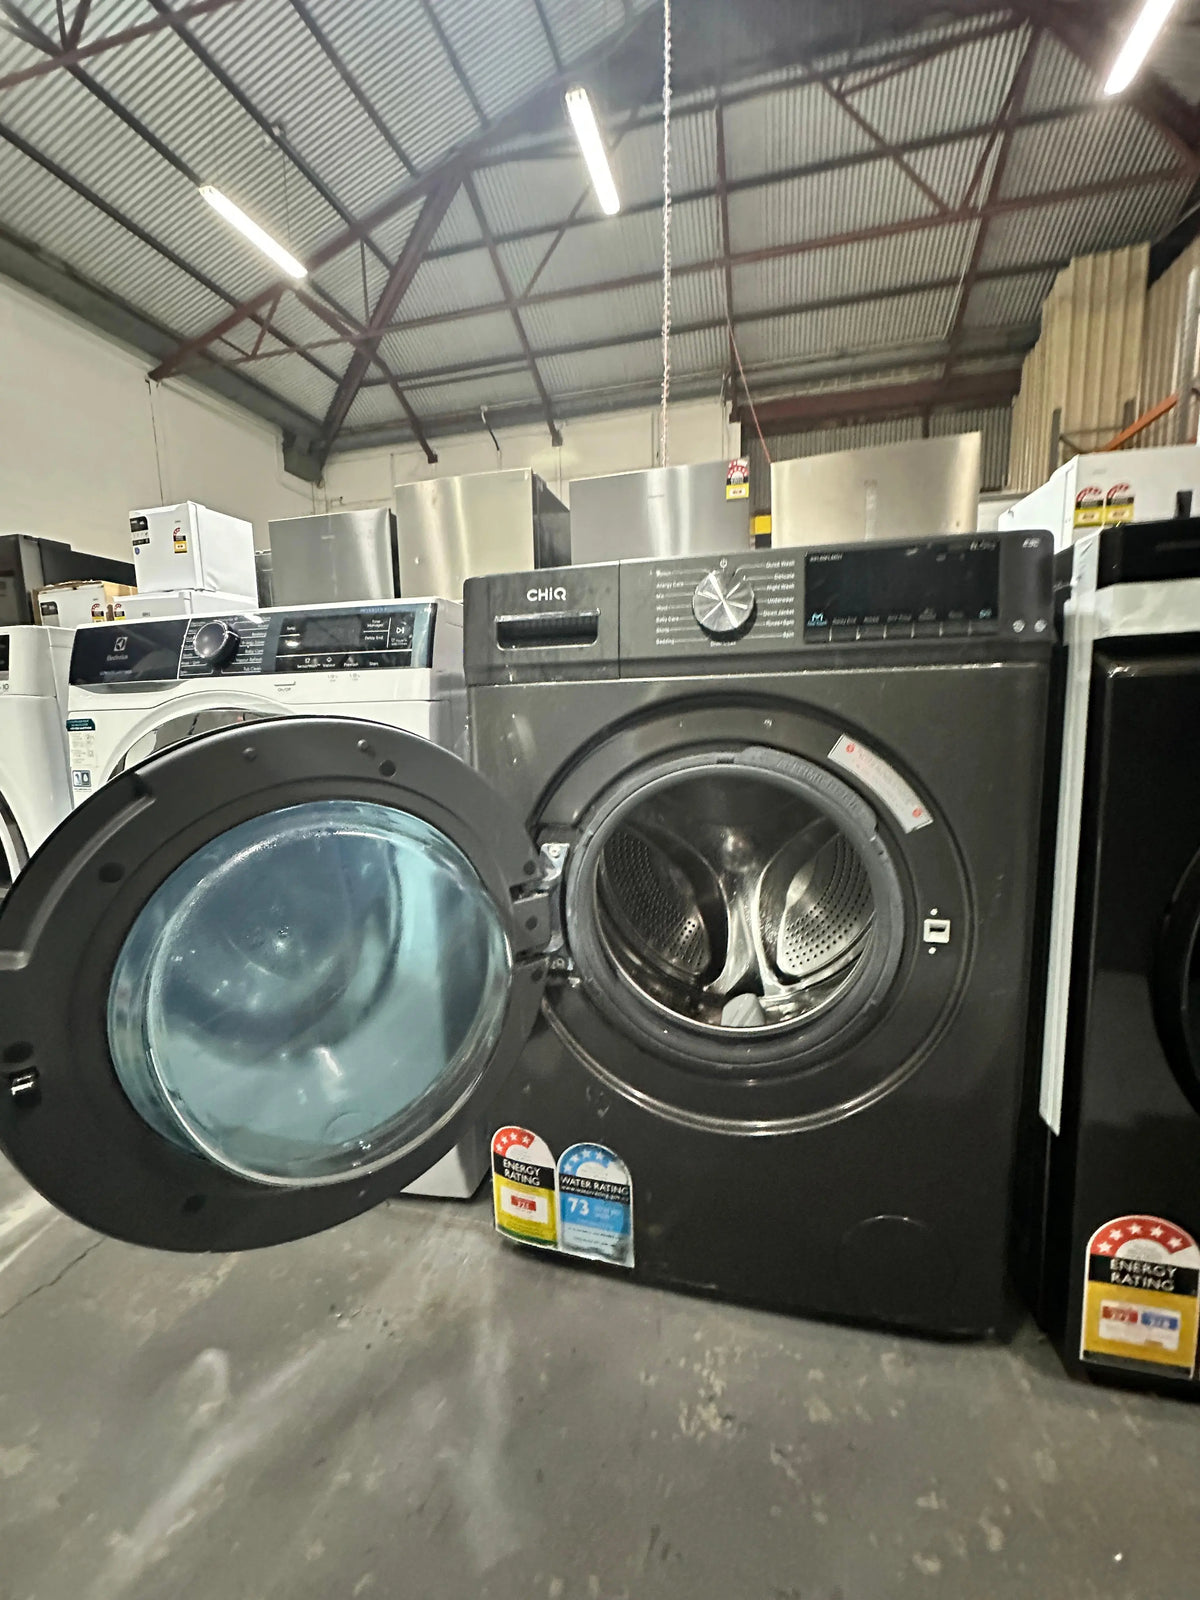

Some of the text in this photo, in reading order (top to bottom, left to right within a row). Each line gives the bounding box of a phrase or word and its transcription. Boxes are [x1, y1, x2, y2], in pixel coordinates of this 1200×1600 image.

[503, 1158, 540, 1177] ENERGY
[504, 1169, 540, 1186] RATING
[561, 1175, 629, 1196] WATER RATING
[567, 1197, 590, 1216] 73
[1110, 1259, 1177, 1278] ENERGY
[1110, 1272, 1175, 1292] RATING
